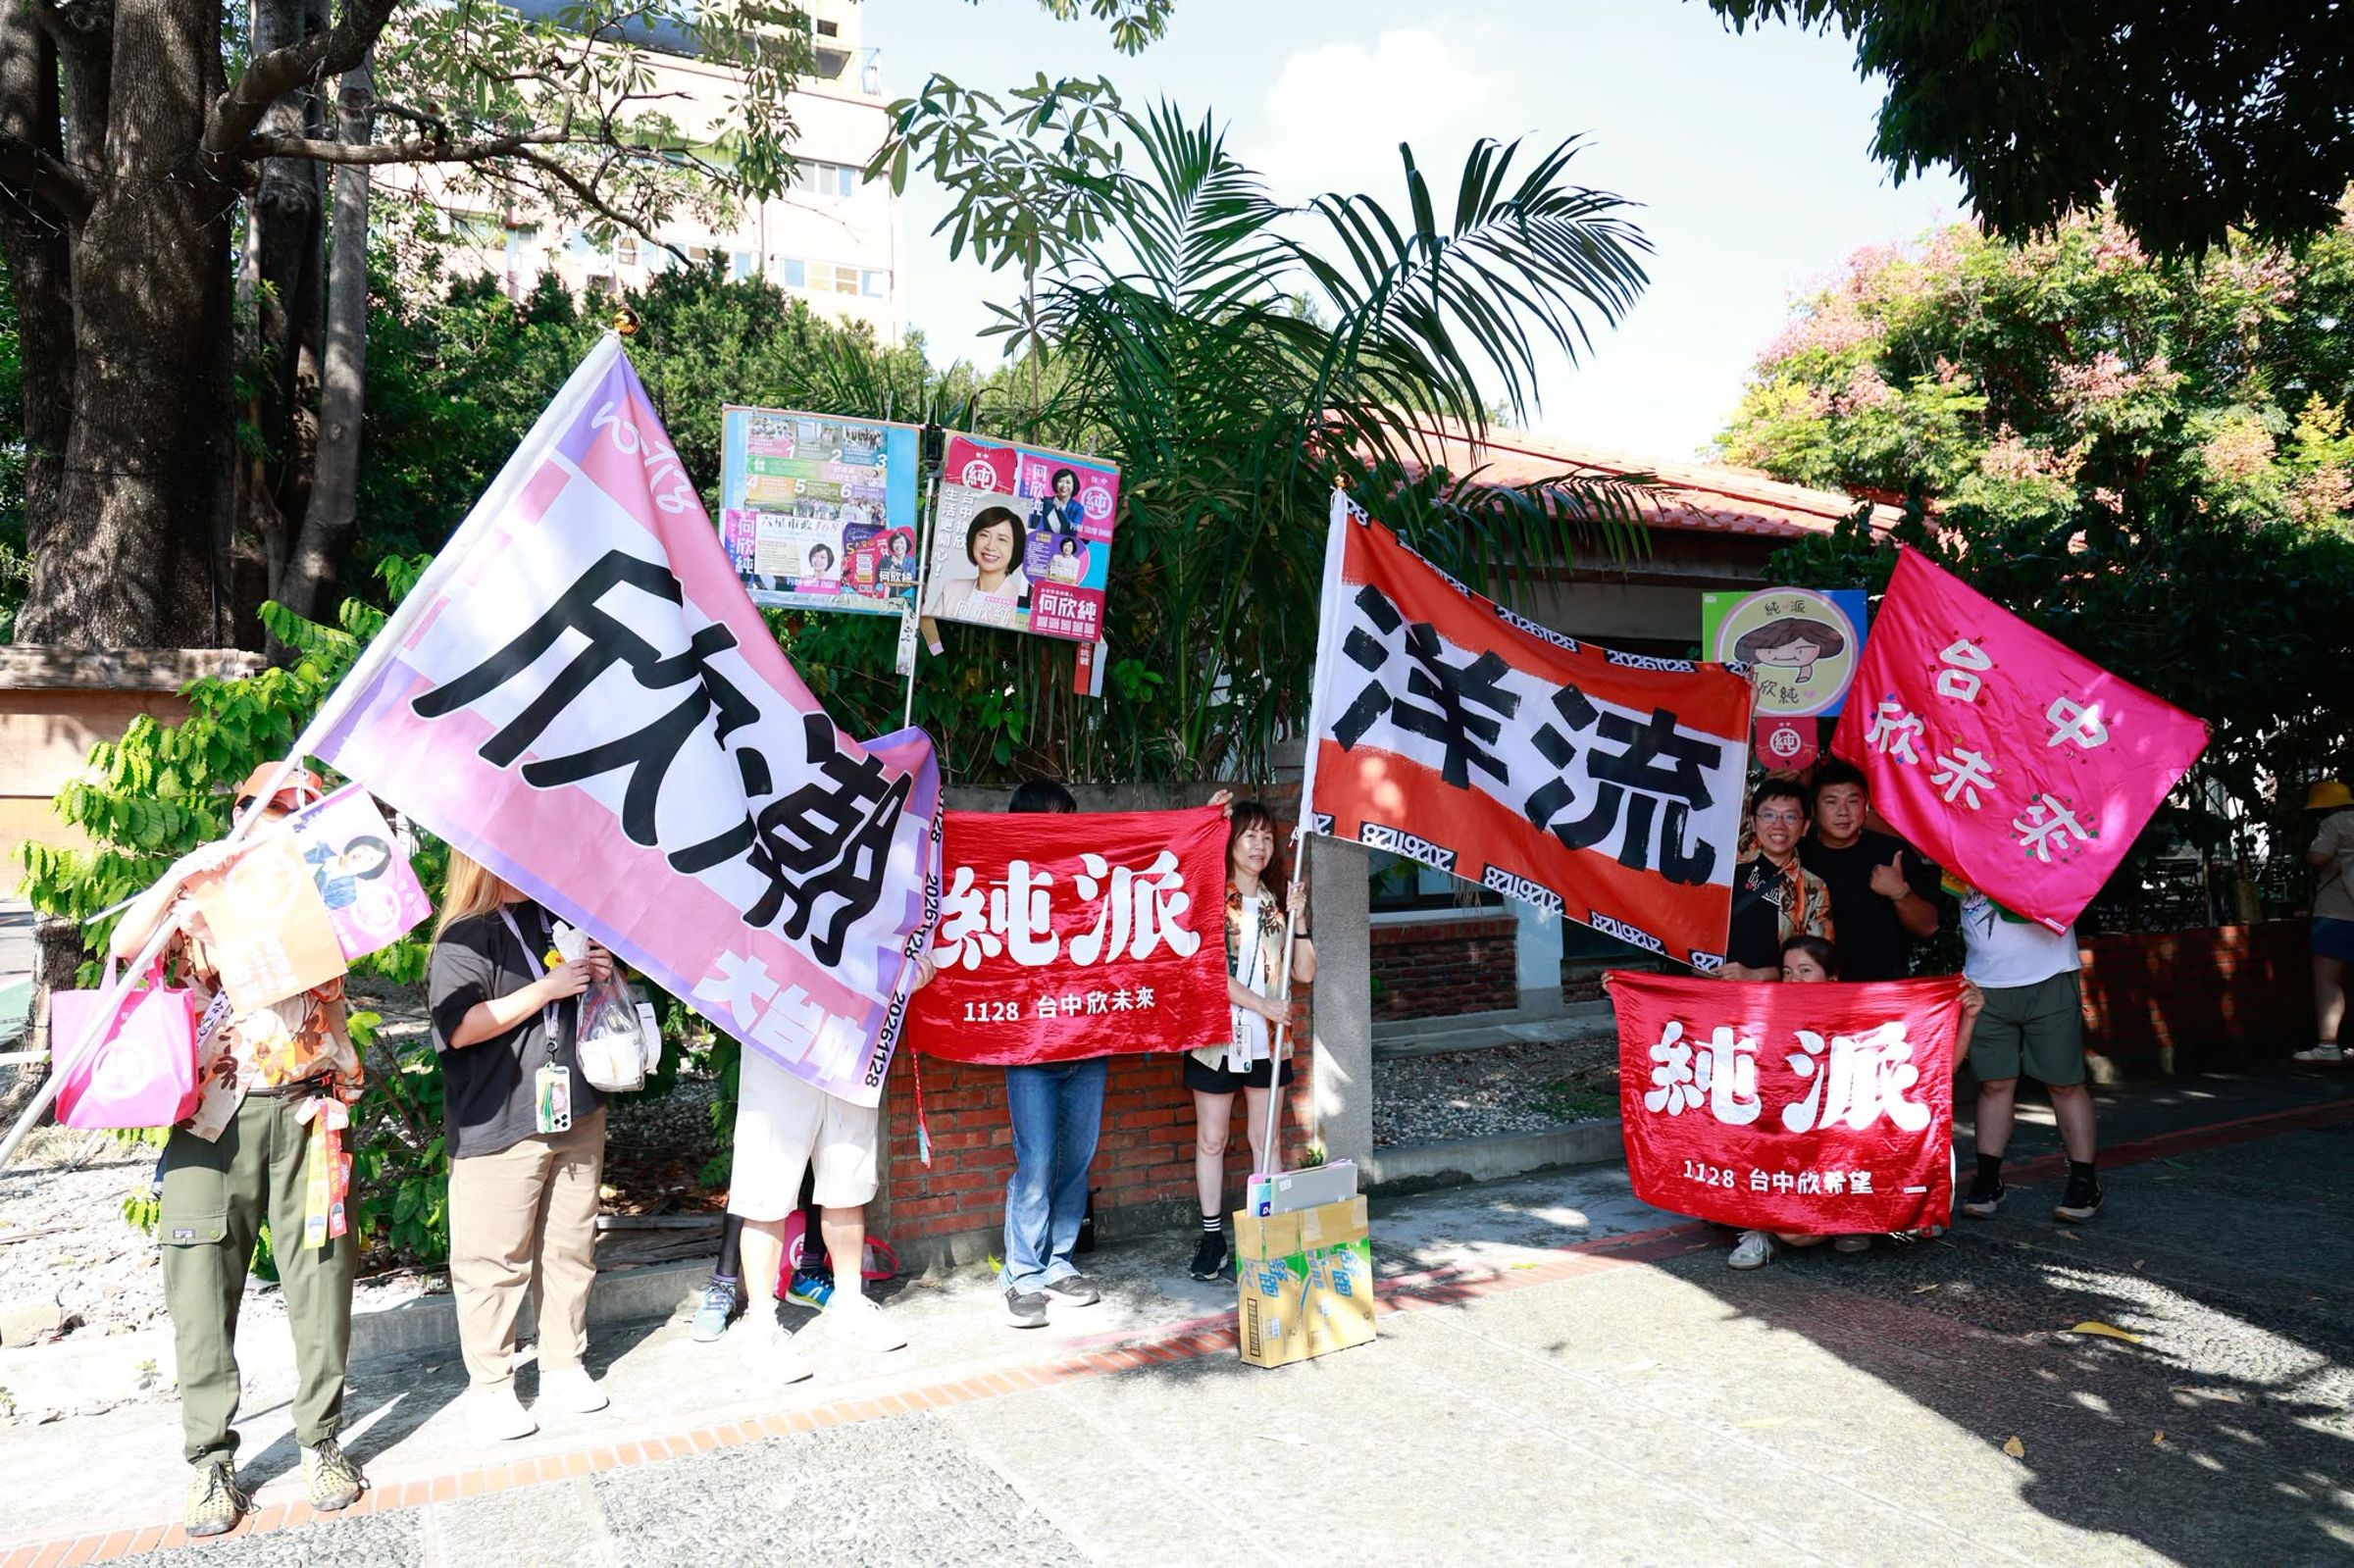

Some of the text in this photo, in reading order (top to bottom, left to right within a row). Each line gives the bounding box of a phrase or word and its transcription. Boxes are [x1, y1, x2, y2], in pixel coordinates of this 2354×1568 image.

[829, 449, 843, 463] 2
[875, 454, 887, 468] 3
[794, 479, 806, 493] 5
[841, 482, 852, 497] 6
[968, 466, 992, 488] 純
[1086, 492, 1106, 514] 純
[736, 520, 755, 574] 何欣純
[1039, 593, 1098, 622] 何欣純
[1498, 607, 1578, 651] 20261128
[1608, 650, 1695, 673] 20261128
[1754, 672, 1800, 704] 欣純
[1936, 638, 2110, 749] 台中
[1331, 582, 1722, 885] 洋流
[1775, 733, 1796, 751] 純
[411, 548, 912, 968] 欣潮
[1362, 823, 1454, 872] 20261128
[1484, 865, 1563, 915] 20261128
[932, 850, 1201, 971] 純派
[691, 950, 869, 1083] 大台中
[963, 986, 1155, 1022] 1128 台中欣未來
[865, 991, 906, 1088] 20261128
[1644, 1021, 1931, 1134] 純派
[1683, 1160, 1874, 1195] 1128 台中欣希望
